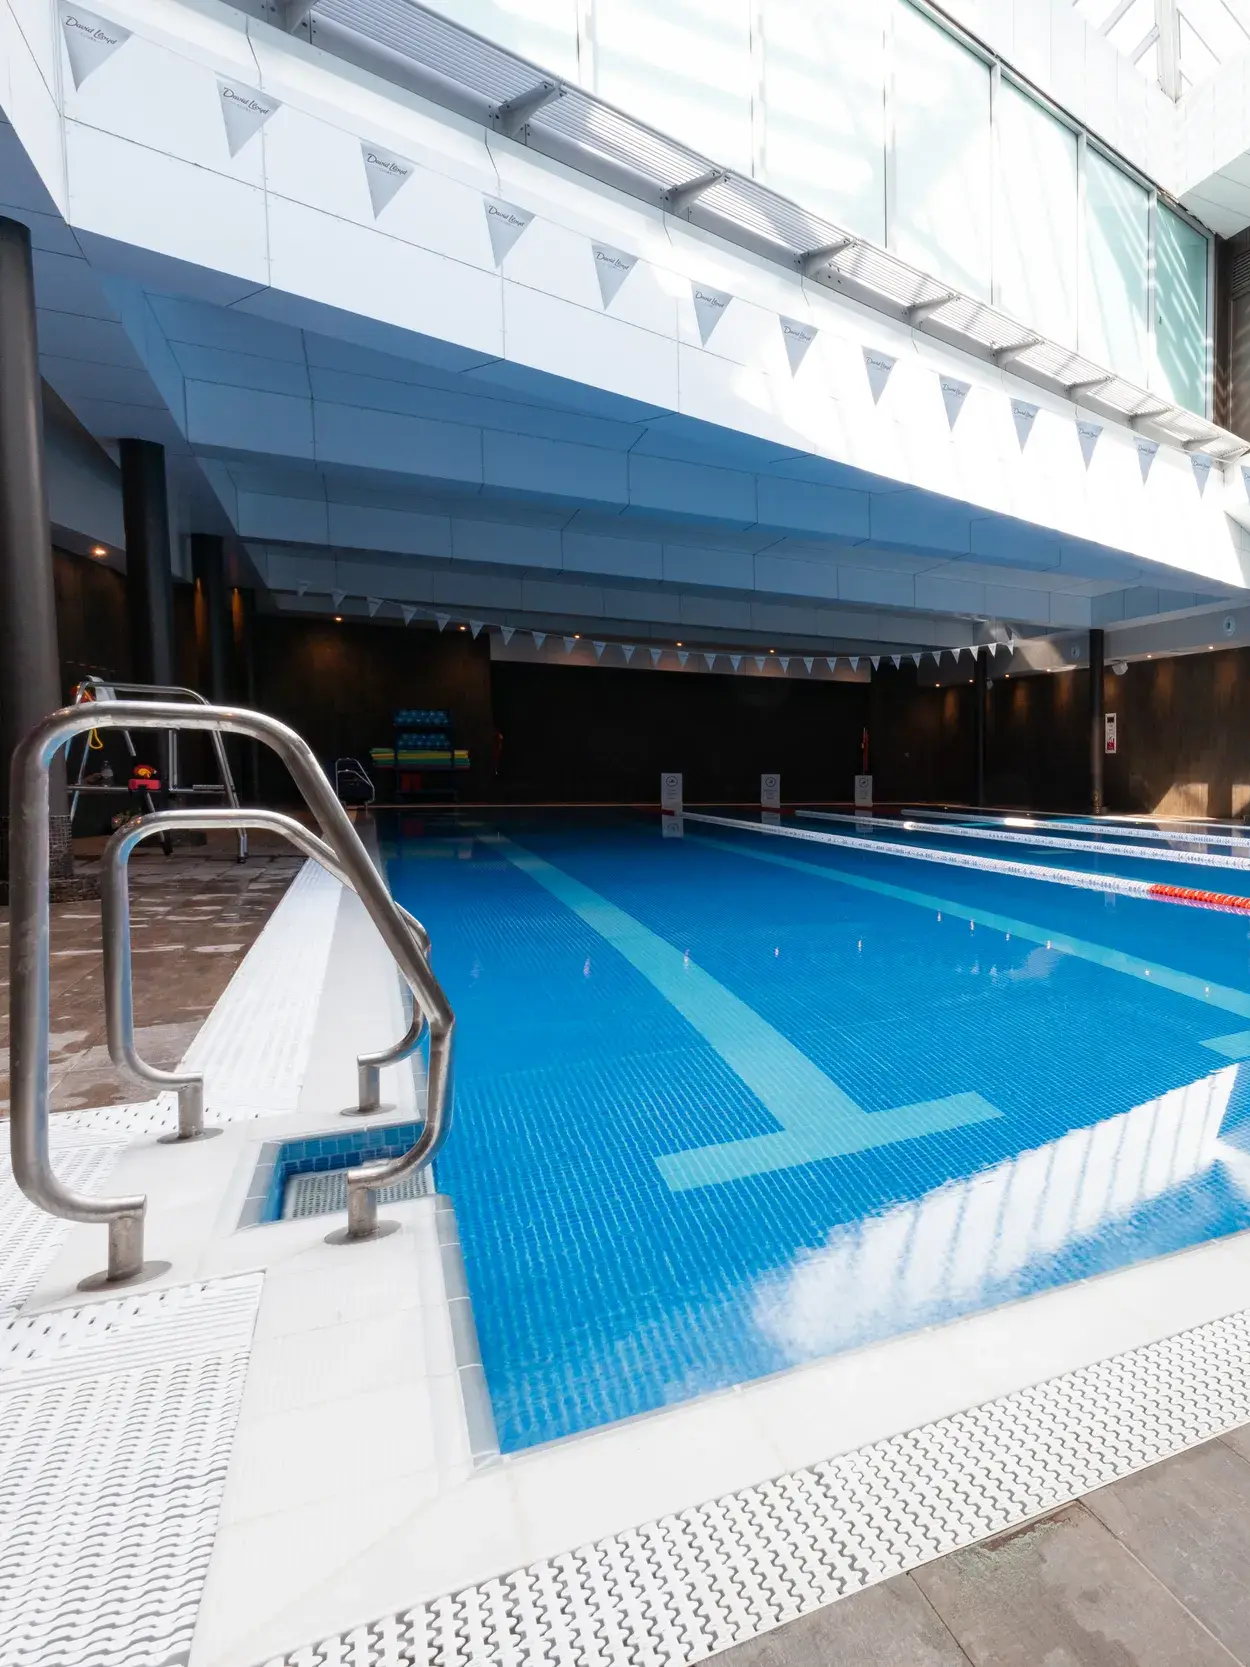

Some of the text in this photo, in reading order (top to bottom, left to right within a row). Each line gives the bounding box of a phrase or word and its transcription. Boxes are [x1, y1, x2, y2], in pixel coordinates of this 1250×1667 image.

[66, 16, 94, 33] David
[94, 30, 118, 44] Lloyd
[223, 86, 249, 104] David
[248, 100, 270, 114] Lloyd
[367, 153, 390, 168] David
[389, 163, 407, 175] Lloyd
[488, 205, 509, 219] David
[508, 215, 524, 226] Lloyd
[596, 251, 615, 263] David
[615, 259, 629, 270] Lloyd
[696, 290, 712, 302] David
